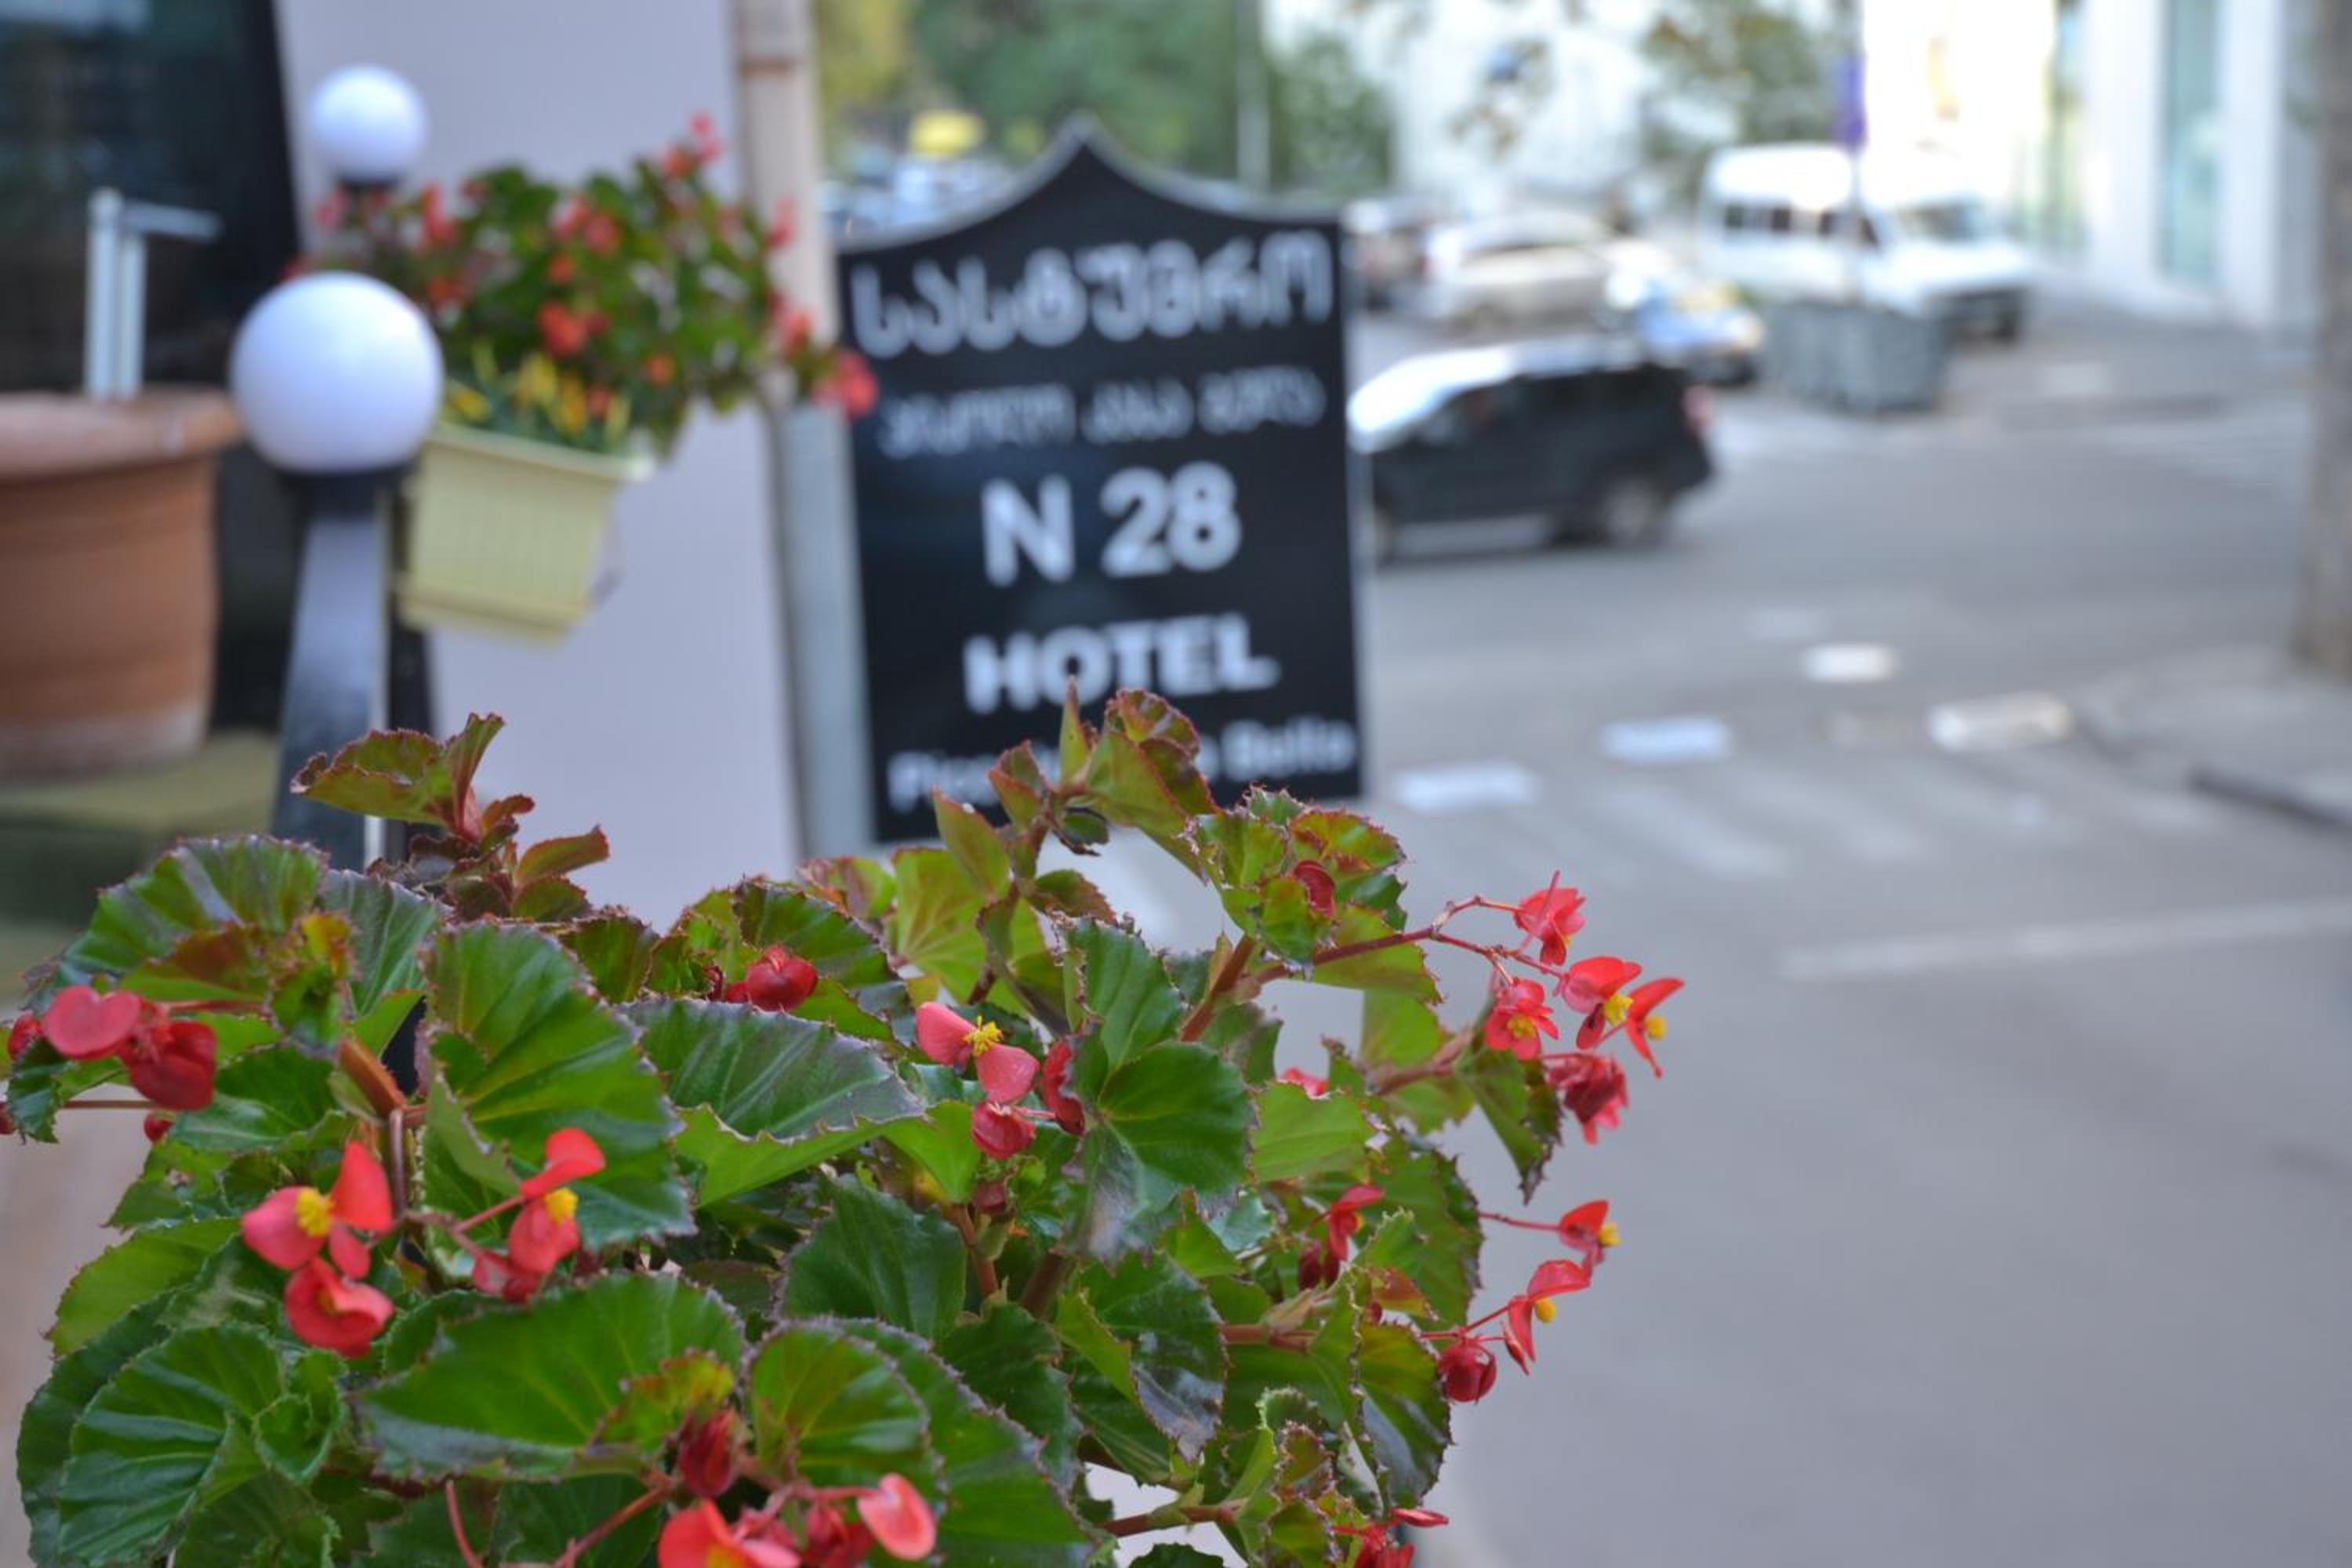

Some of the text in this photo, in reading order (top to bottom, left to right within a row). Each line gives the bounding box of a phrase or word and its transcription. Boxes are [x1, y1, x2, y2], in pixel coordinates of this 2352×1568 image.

[851, 232, 1333, 358] სასტუმრო
[982, 461, 1241, 586] N 28
[964, 612, 1279, 714] HOTEL
